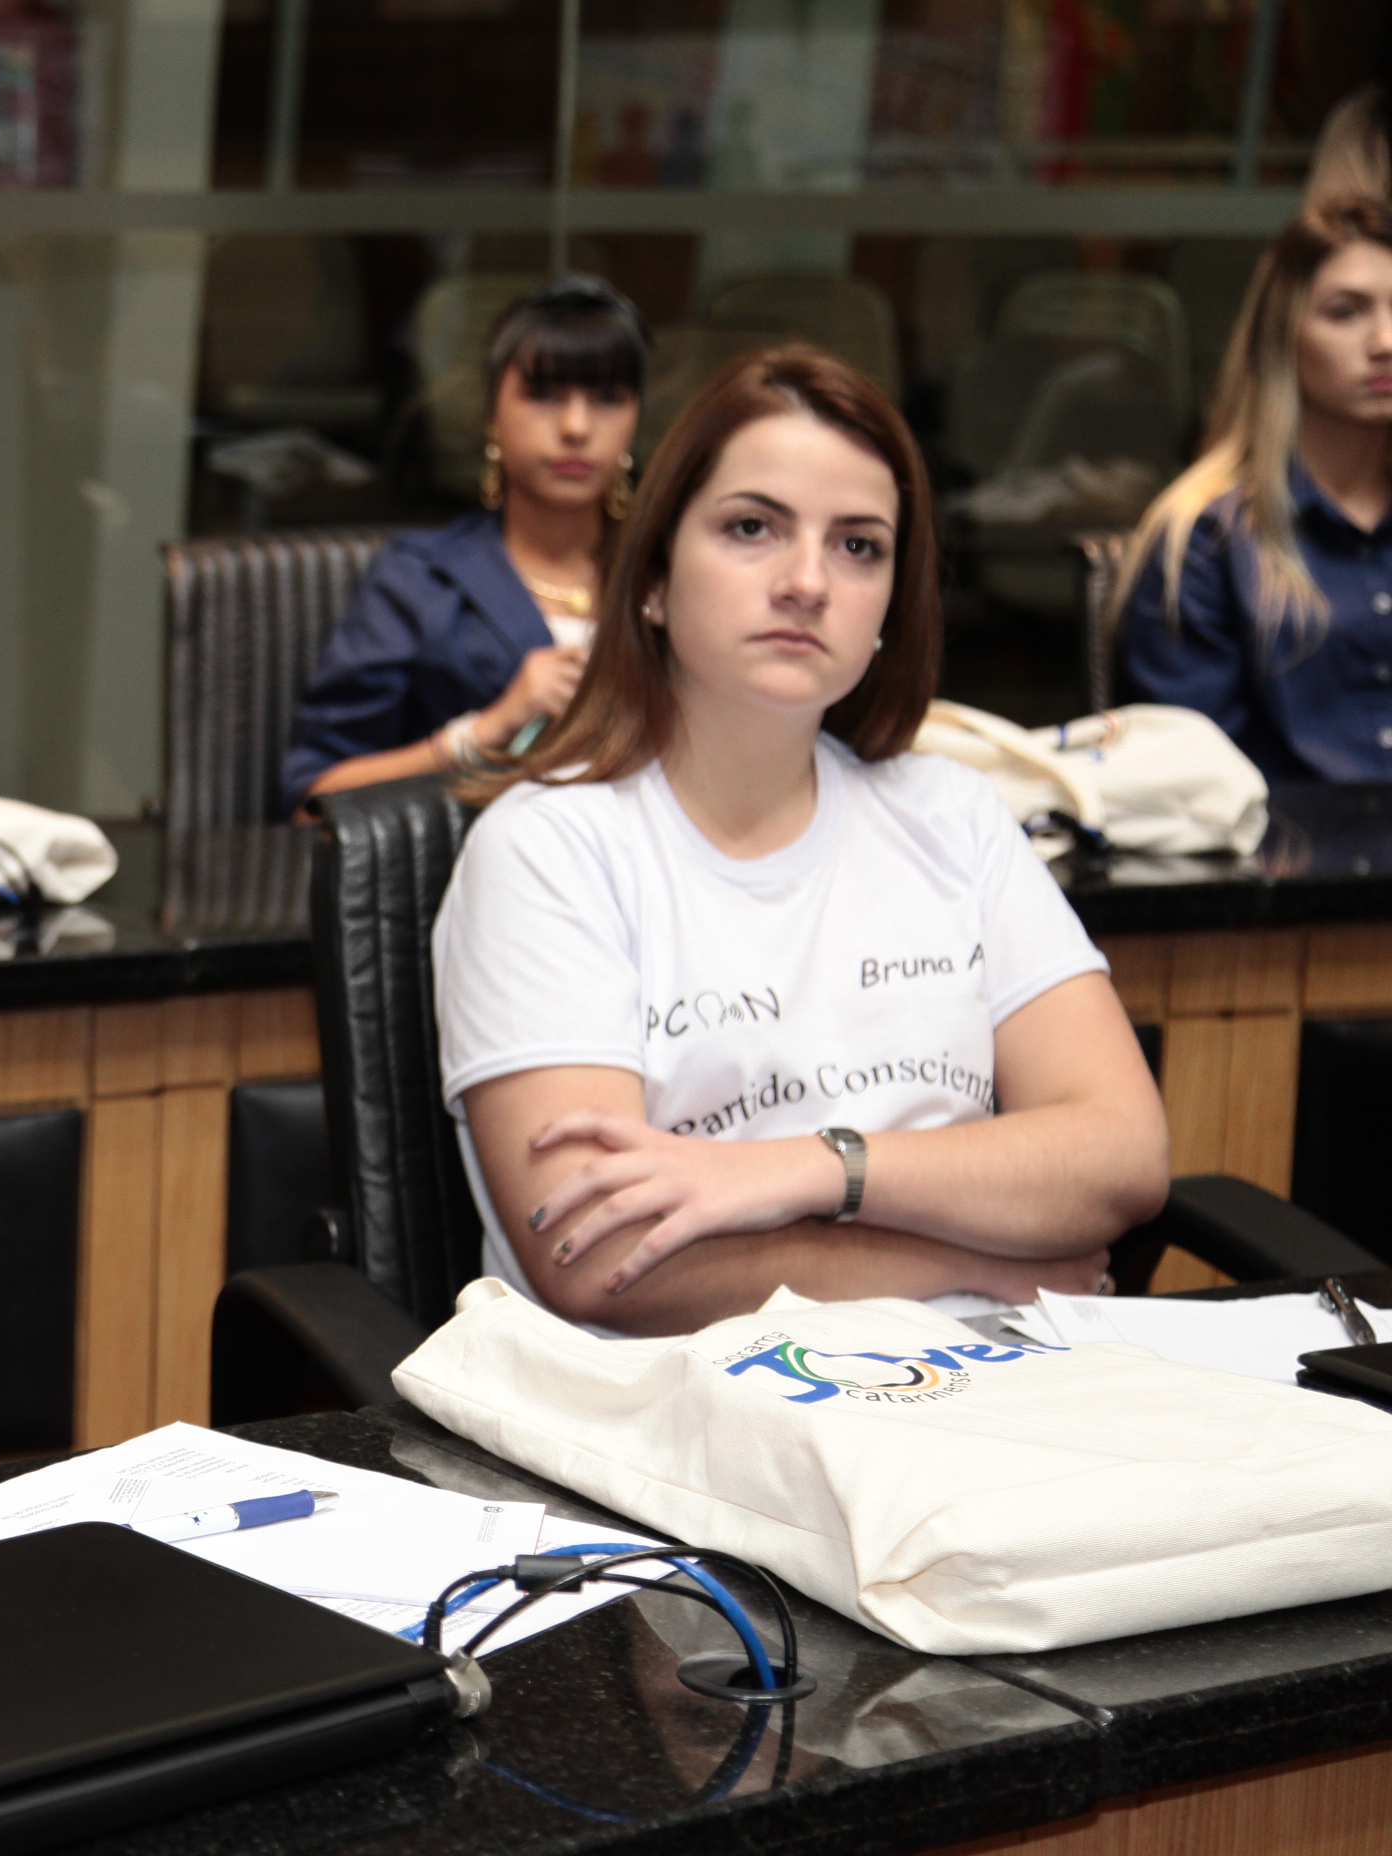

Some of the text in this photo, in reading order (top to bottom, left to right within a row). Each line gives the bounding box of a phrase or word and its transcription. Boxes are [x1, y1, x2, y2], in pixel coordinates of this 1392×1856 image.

[860, 955, 955, 988] Bruna
[669, 1072, 807, 1137] Partido
[845, 1370, 971, 1405] catarinense
